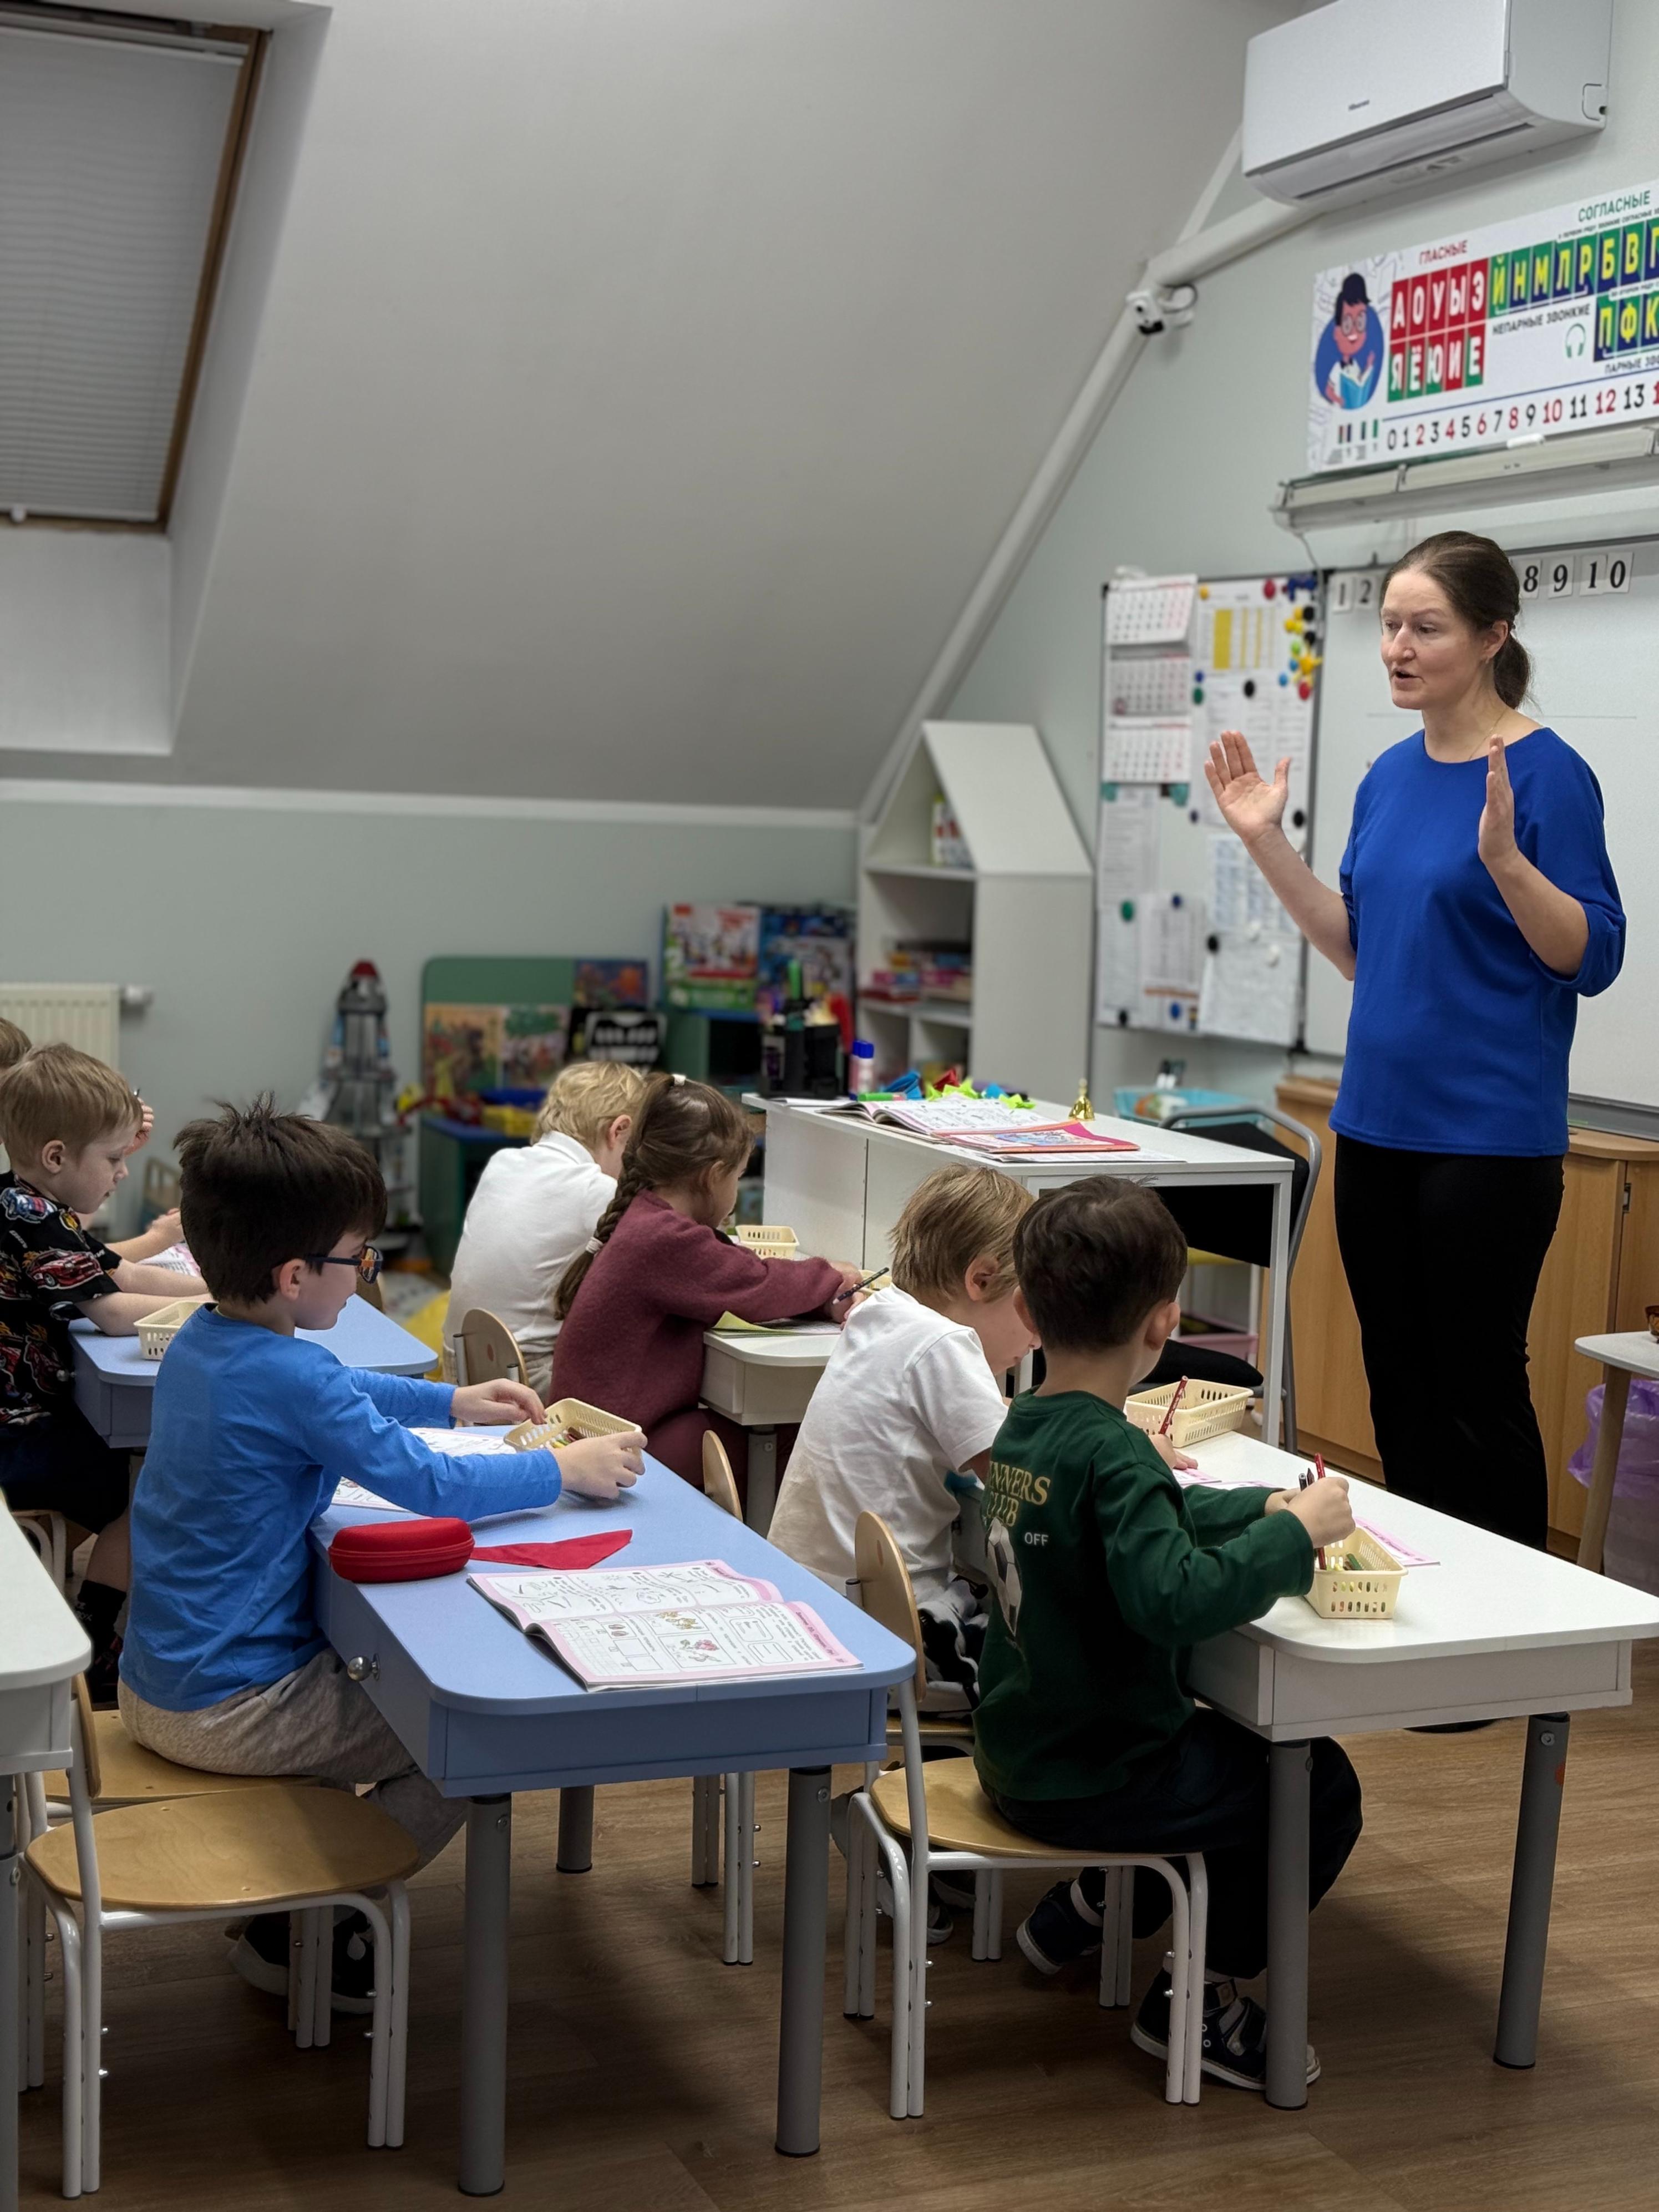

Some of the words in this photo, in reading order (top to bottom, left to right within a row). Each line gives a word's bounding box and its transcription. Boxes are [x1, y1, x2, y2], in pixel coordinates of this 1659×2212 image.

[1578, 190, 1651, 222] СОГЛАСНЫЕ
[1419, 239, 1468, 265] ГЛАСНЫЕ
[1492, 255, 1506, 306] Й
[1513, 260, 1526, 301] Н
[1534, 255, 1549, 296] М
[1556, 249, 1570, 290] Л
[1579, 244, 1592, 285] Р
[1601, 237, 1615, 280] Б
[1624, 232, 1638, 275] В
[1393, 291, 1405, 329] А
[1412, 285, 1425, 325] О
[1432, 280, 1445, 320] У
[1449, 275, 1466, 316] Ы
[1472, 270, 1484, 311] Э
[1492, 314, 1544, 335] НЕПАРНЫЕ
[1546, 303, 1590, 323] ЗВОНКИЕ
[1598, 306, 1612, 348] П
[1620, 302, 1637, 344] Ф
[1391, 353, 1403, 391] Я
[1409, 345, 1422, 391] Ё
[1427, 344, 1443, 384] Ю
[1448, 340, 1462, 379] И
[1469, 336, 1482, 376] Е
[1387, 429, 1397, 450] 0
[1403, 426, 1409, 448] 1
[1416, 423, 1425, 446] 2
[1430, 421, 1439, 443] 3
[1445, 418, 1455, 439] 4
[1462, 415, 1470, 438] 5
[1477, 413, 1486, 435] 6
[1494, 409, 1503, 433] 7
[1509, 407, 1518, 429] 8
[1526, 403, 1536, 427] 9
[1543, 398, 1562, 424] 10
[1570, 393, 1587, 419] 11
[1595, 388, 1616, 415] 12
[1624, 383, 1645, 410] 13
[1338, 582, 1346, 607] 1
[1359, 579, 1372, 605] 2
[1523, 565, 1539, 593] 8
[1553, 564, 1568, 593] 9
[1024, 1532, 1049, 1546] OFF
